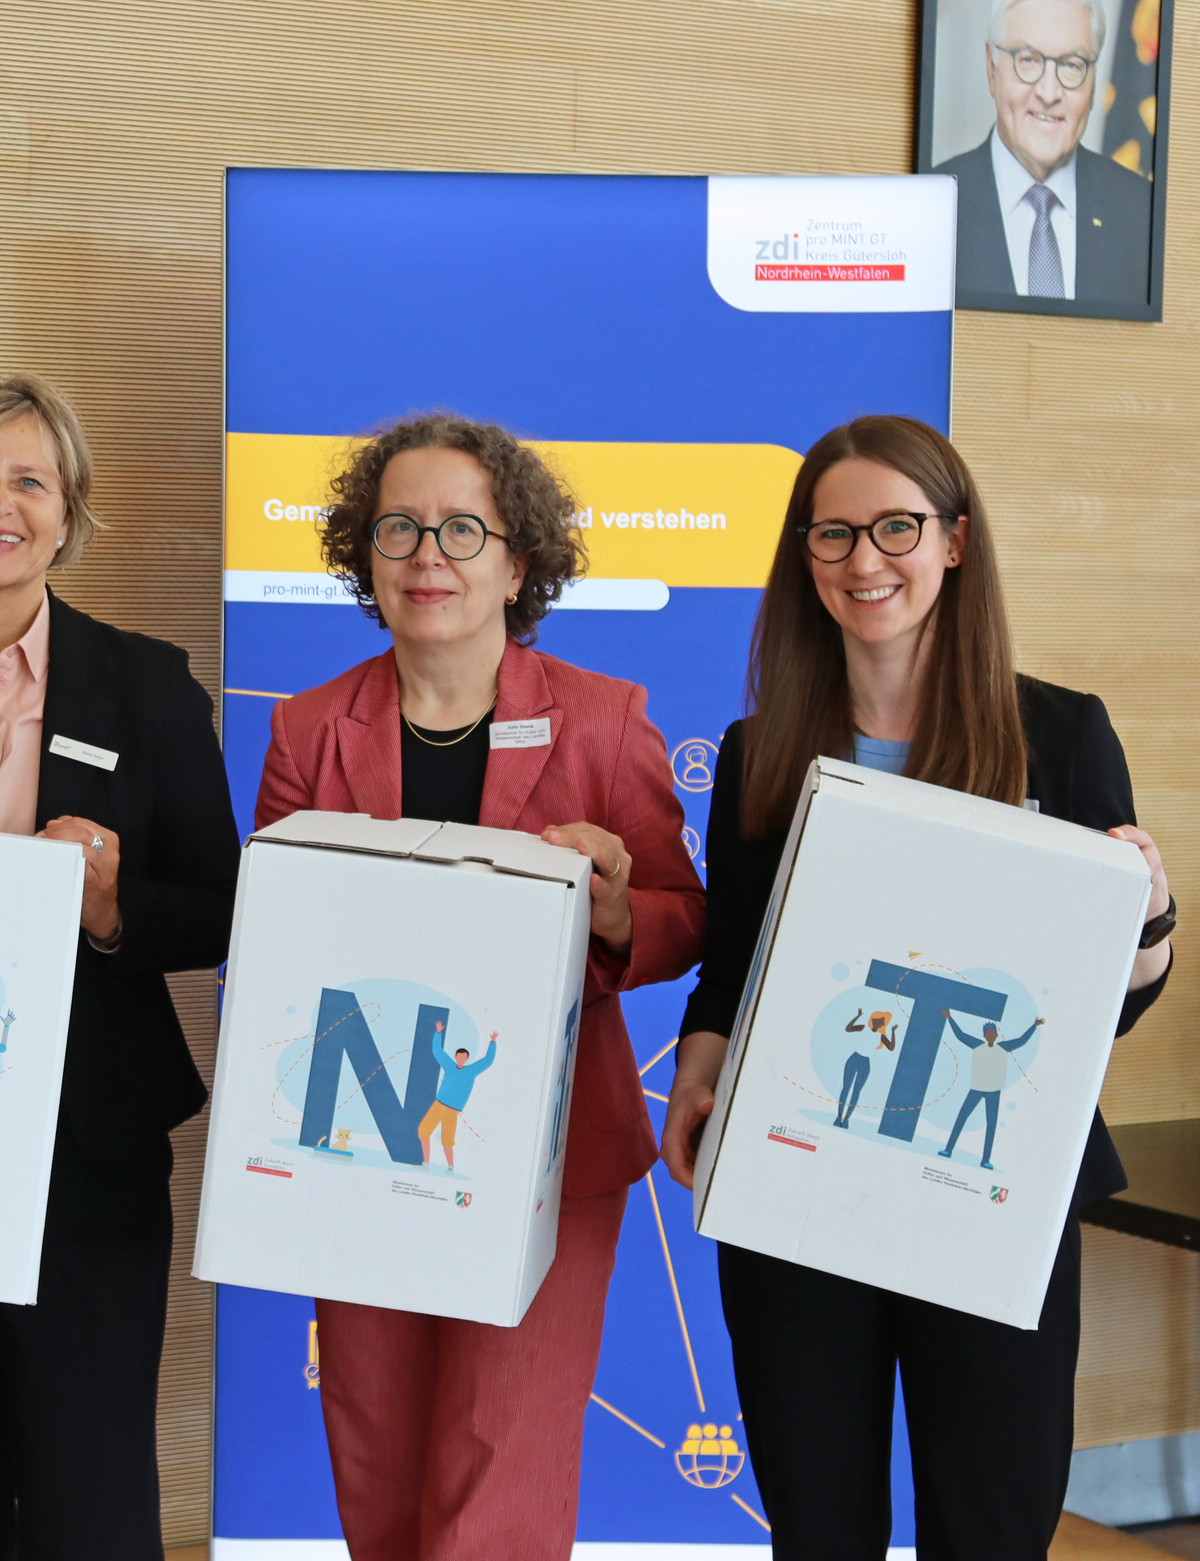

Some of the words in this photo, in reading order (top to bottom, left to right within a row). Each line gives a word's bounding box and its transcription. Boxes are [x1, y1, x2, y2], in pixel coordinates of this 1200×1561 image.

[806, 219, 862, 231] Zentrum
[755, 233, 799, 260] zdi
[806, 236, 828, 247] pro
[832, 233, 865, 245] MINT
[870, 233, 887, 245] GT
[806, 250, 839, 261] Kreis
[843, 250, 907, 261] Gütersloh
[757, 266, 890, 280] Nordrhein-Westfalen
[600, 508, 727, 530] verstehen
[864, 959, 1011, 1143] T
[299, 986, 449, 1166] N
[769, 1124, 787, 1136] zdi
[247, 1156, 263, 1166] zdi
